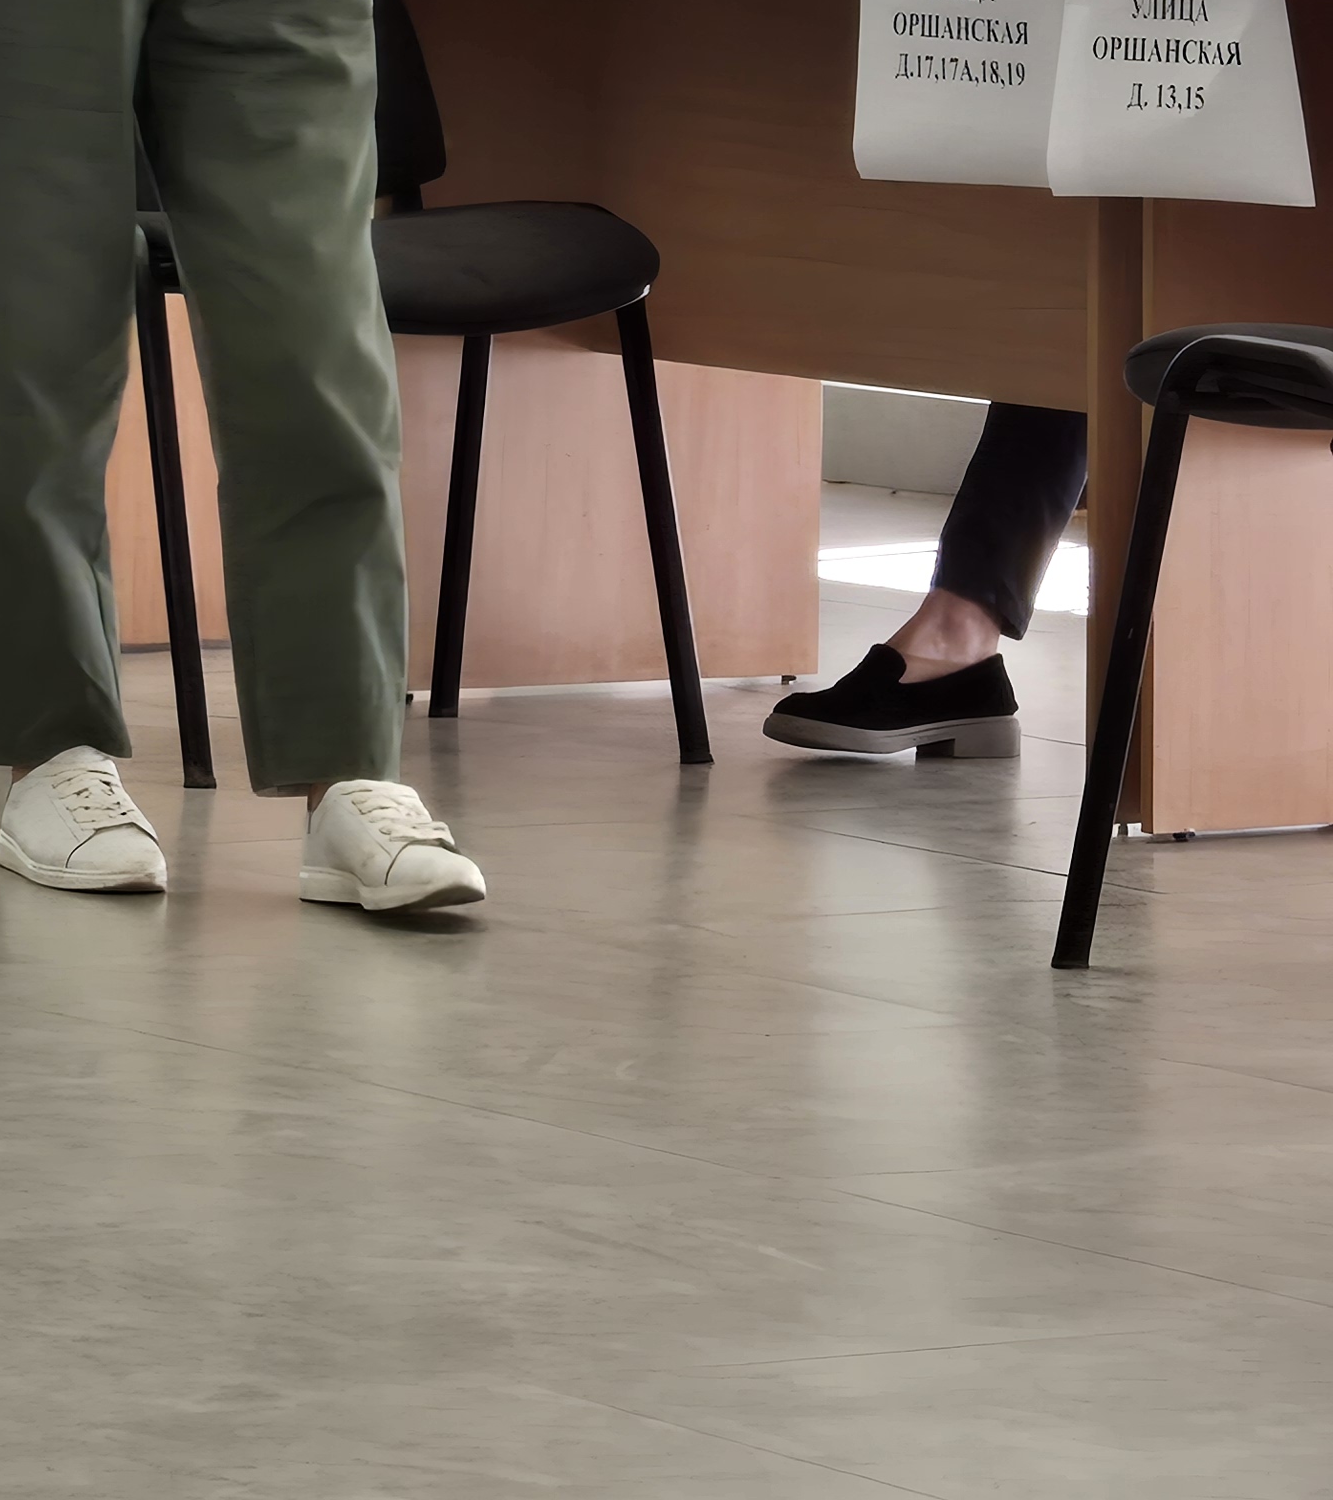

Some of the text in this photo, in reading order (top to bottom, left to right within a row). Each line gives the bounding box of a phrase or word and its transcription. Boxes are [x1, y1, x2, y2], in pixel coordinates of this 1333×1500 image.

[892, 11, 1030, 46] ОРШАНСКАЯ
[1092, 35, 1243, 67] ОРШАНСКАЯ
[1155, 83, 1206, 114] 13,15
